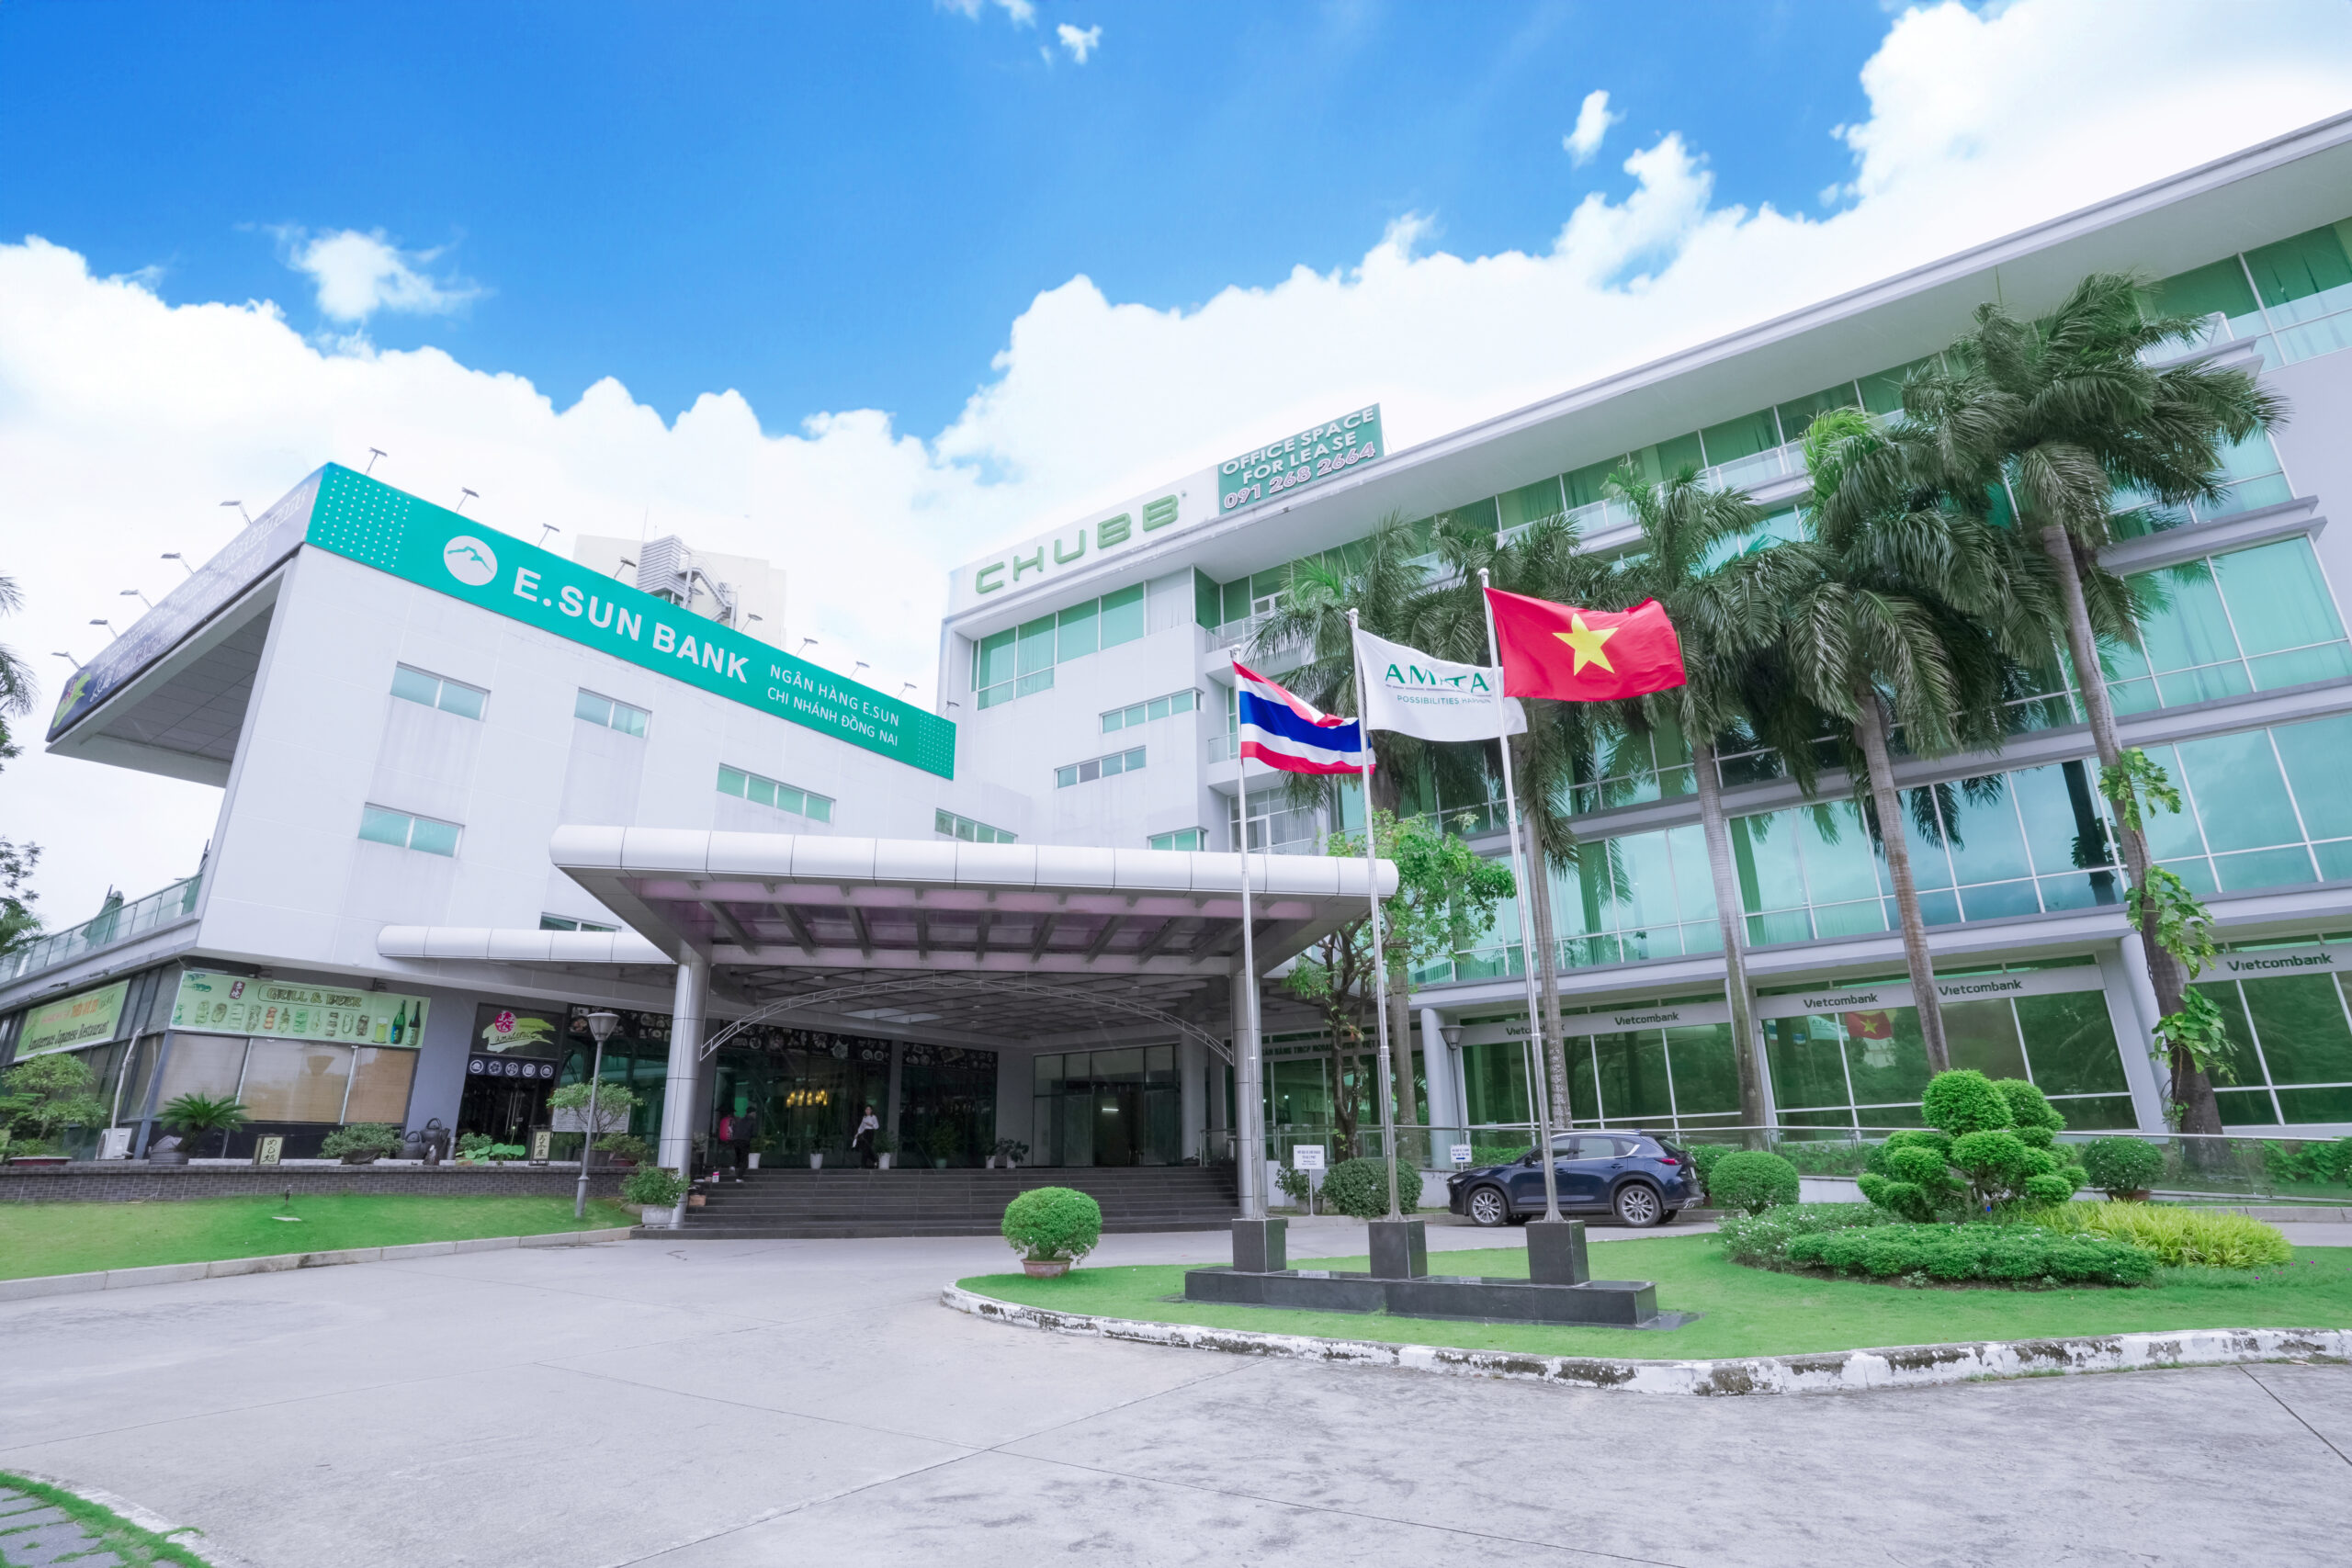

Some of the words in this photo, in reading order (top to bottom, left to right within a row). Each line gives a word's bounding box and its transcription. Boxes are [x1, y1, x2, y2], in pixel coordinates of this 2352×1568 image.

[1222, 437, 1295, 475] OFFICE
[1300, 407, 1374, 446] SPACE
[1243, 459, 1283, 485] FOR
[1290, 431, 1357, 468] LEASE
[1224, 483, 1261, 509] 091
[1269, 465, 1312, 494] 268
[1317, 441, 1375, 477] 2664
[975, 493, 1180, 594] CHUBB
[513, 566, 643, 643] E.SUN
[652, 622, 750, 684] BANK
[767, 687, 789, 705] CHI
[794, 696, 838, 724] NHÁNH
[842, 714, 876, 738] ĐỒNG
[879, 729, 899, 747] NAI
[770, 664, 814, 693] NGÂN
[819, 683, 858, 710] HÀNG
[863, 701, 899, 727] E.SUN
[1397, 694, 1460, 705] POSSIBILITIES
[1938, 979, 2023, 996] Vietcombank
[2227, 953, 2334, 972] Vietcombank
[266, 987, 308, 1003] GRILL
[310, 992, 322, 1004] &
[325, 993, 362, 1008] BEER
[1614, 1011, 1679, 1026] Vietcombank
[1803, 993, 1879, 1009] Vietcombank
